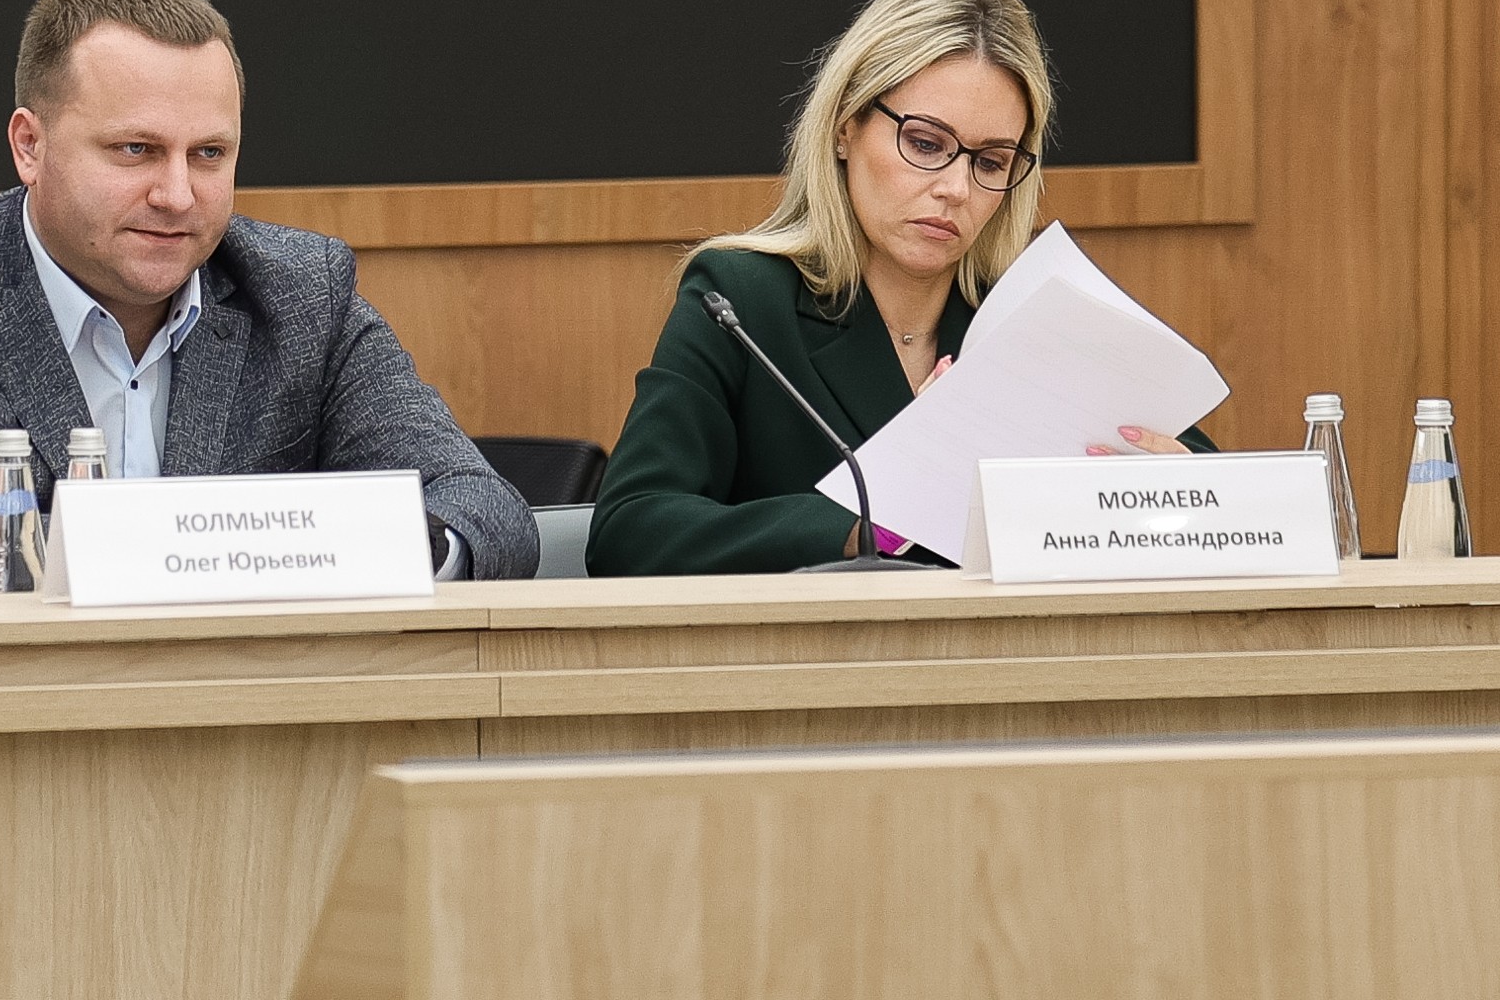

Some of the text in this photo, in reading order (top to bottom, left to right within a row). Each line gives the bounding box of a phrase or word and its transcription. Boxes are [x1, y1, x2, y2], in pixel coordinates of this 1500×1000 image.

[1098, 489, 1220, 510] МОЖАЕВА
[175, 510, 316, 534] КОЛМЫЧЕК
[1043, 530, 1284, 551] Анна Александровна
[164, 551, 337, 575] Олег Юрьевич
